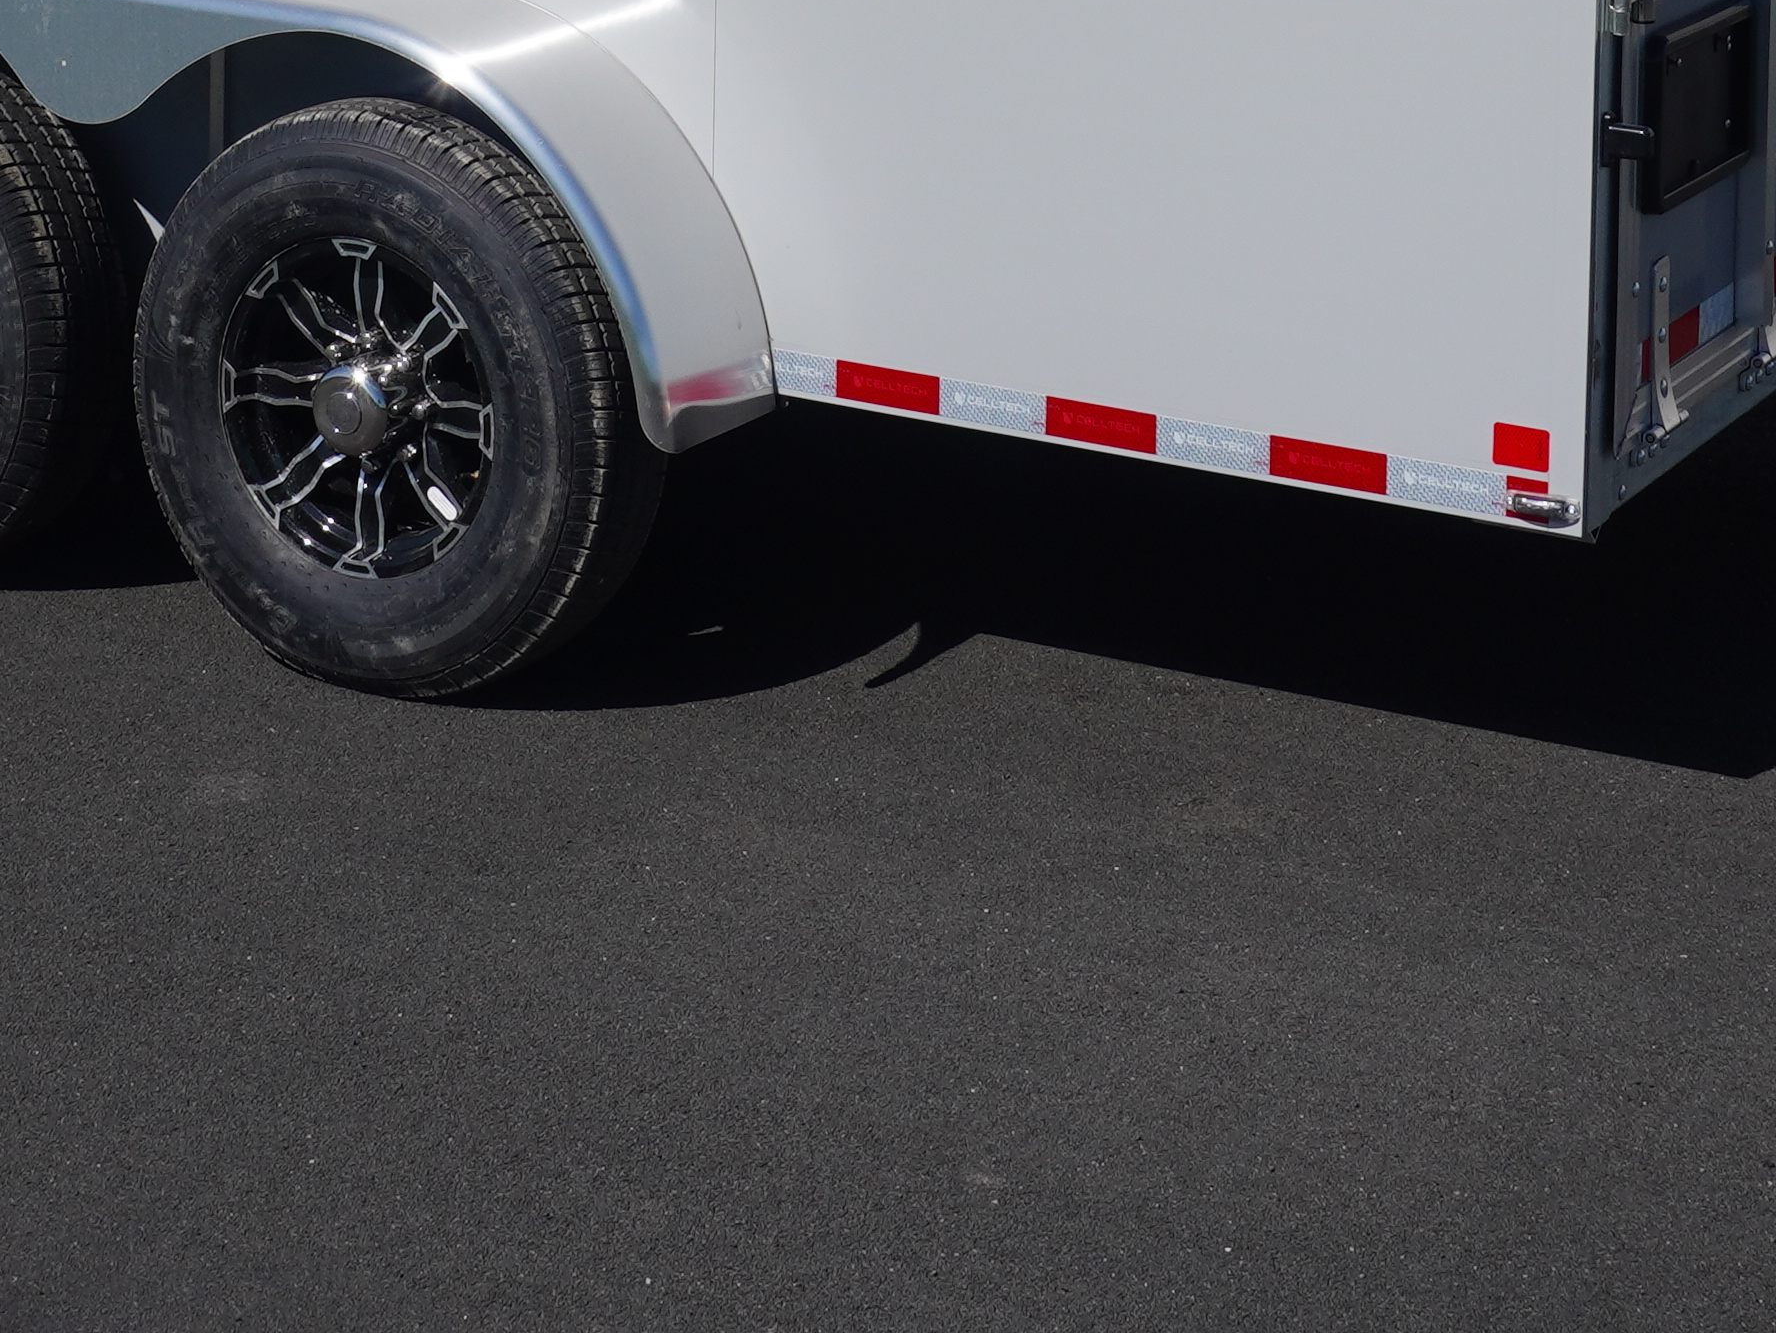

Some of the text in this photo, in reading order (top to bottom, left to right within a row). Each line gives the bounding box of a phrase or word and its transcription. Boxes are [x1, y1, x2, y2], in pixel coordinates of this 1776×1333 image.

[865, 376, 928, 397] CELLTECH
[1075, 412, 1141, 434] CELLTECH
[1302, 453, 1372, 475] CELLTECH
